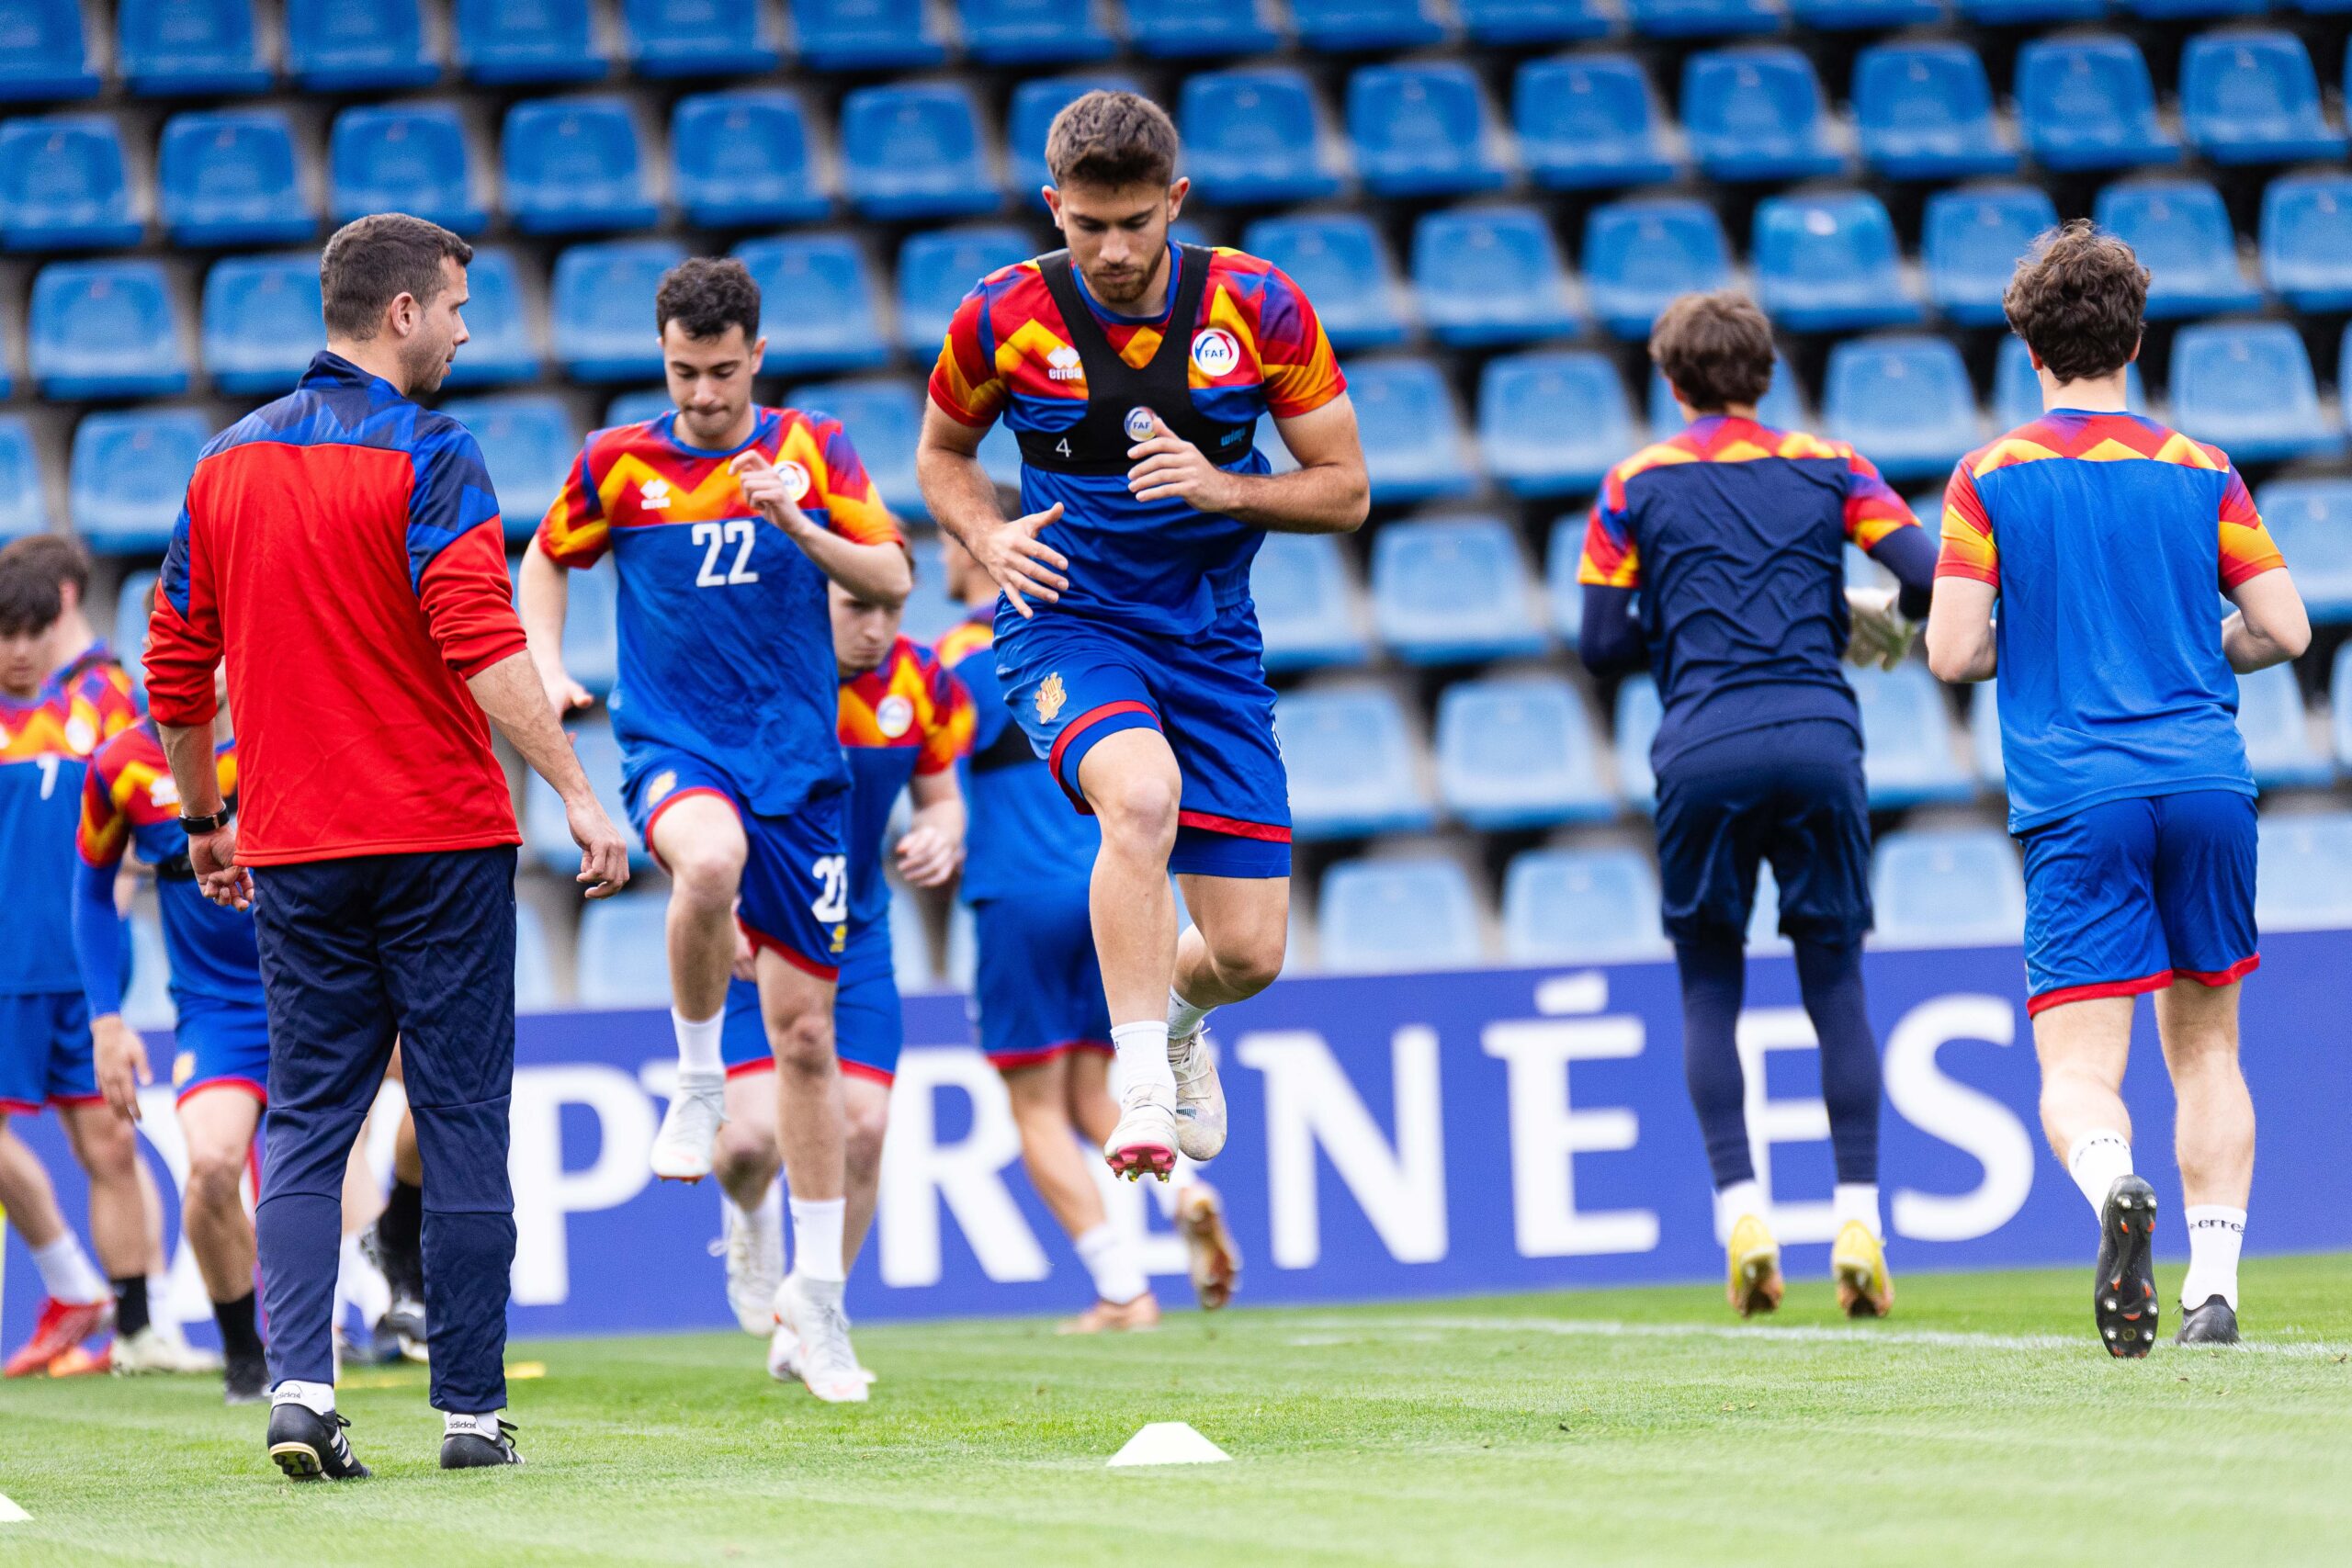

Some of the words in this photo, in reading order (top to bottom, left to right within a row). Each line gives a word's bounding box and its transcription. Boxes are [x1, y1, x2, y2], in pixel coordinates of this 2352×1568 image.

[1204, 349, 1226, 358] FAF
[1048, 367, 1083, 380] errea
[1133, 421, 1150, 429] FAF
[1056, 437, 1072, 457] 4
[692, 520, 759, 587] 22
[37, 752, 60, 801] 7
[508, 971, 2035, 1305] PRNÉES
